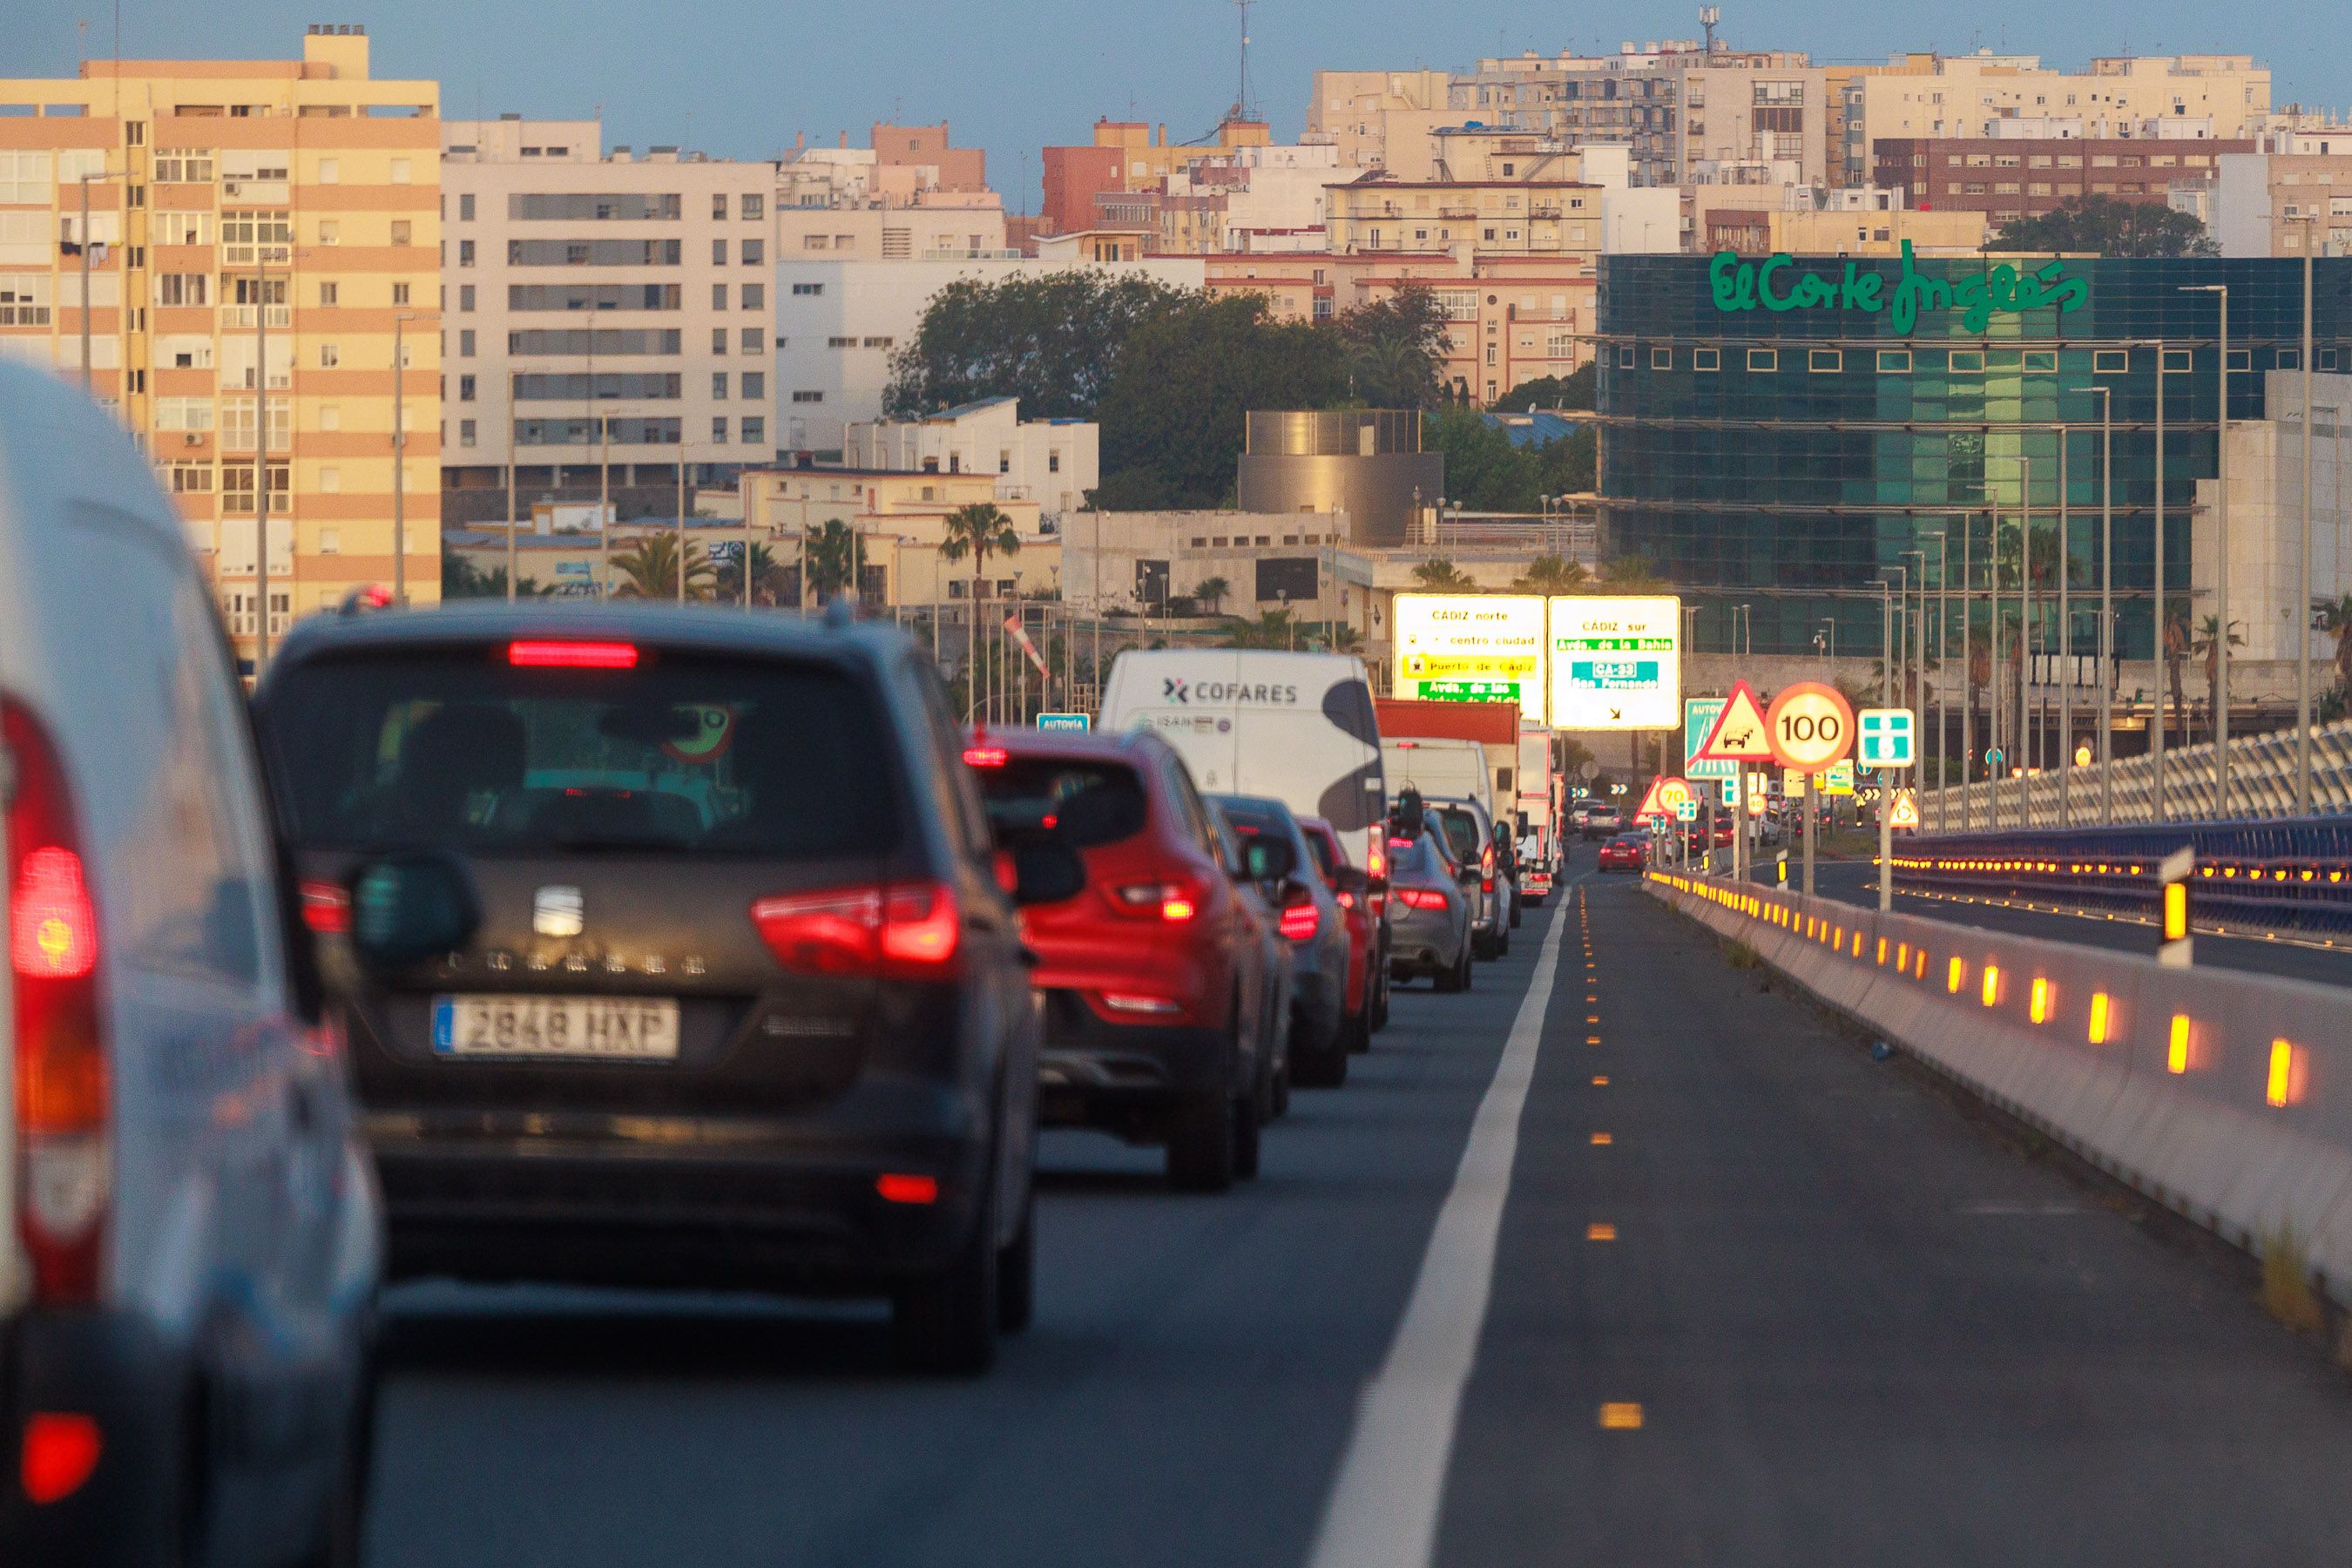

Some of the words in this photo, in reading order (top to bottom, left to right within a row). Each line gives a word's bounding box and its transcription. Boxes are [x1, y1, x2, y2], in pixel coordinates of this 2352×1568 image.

[1710, 250, 1755, 312] El
[1759, 253, 1883, 312] Corte
[1891, 239, 2089, 335] Inglés
[1432, 609, 1469, 621] CÁDIZ
[1476, 611, 1509, 621] norte
[1582, 619, 1619, 632] CÁDIZ
[1627, 623, 1647, 632] sur
[1450, 635, 1489, 645] centro
[1496, 635, 1535, 645] ciudad
[1558, 639, 1592, 650] Avda.
[1598, 639, 1613, 650] de
[1619, 639, 1632, 650] la
[1429, 682, 1463, 693] Avda.
[1470, 683, 1486, 693] de
[1490, 683, 1511, 693] las
[1571, 678, 1596, 689] San
[1601, 678, 1658, 689] Fernando
[1195, 681, 1297, 703] COFARES
[1044, 719, 1083, 731] AUTOVÍA
[1781, 715, 1839, 741] 100
[1664, 789, 1684, 803] 70
